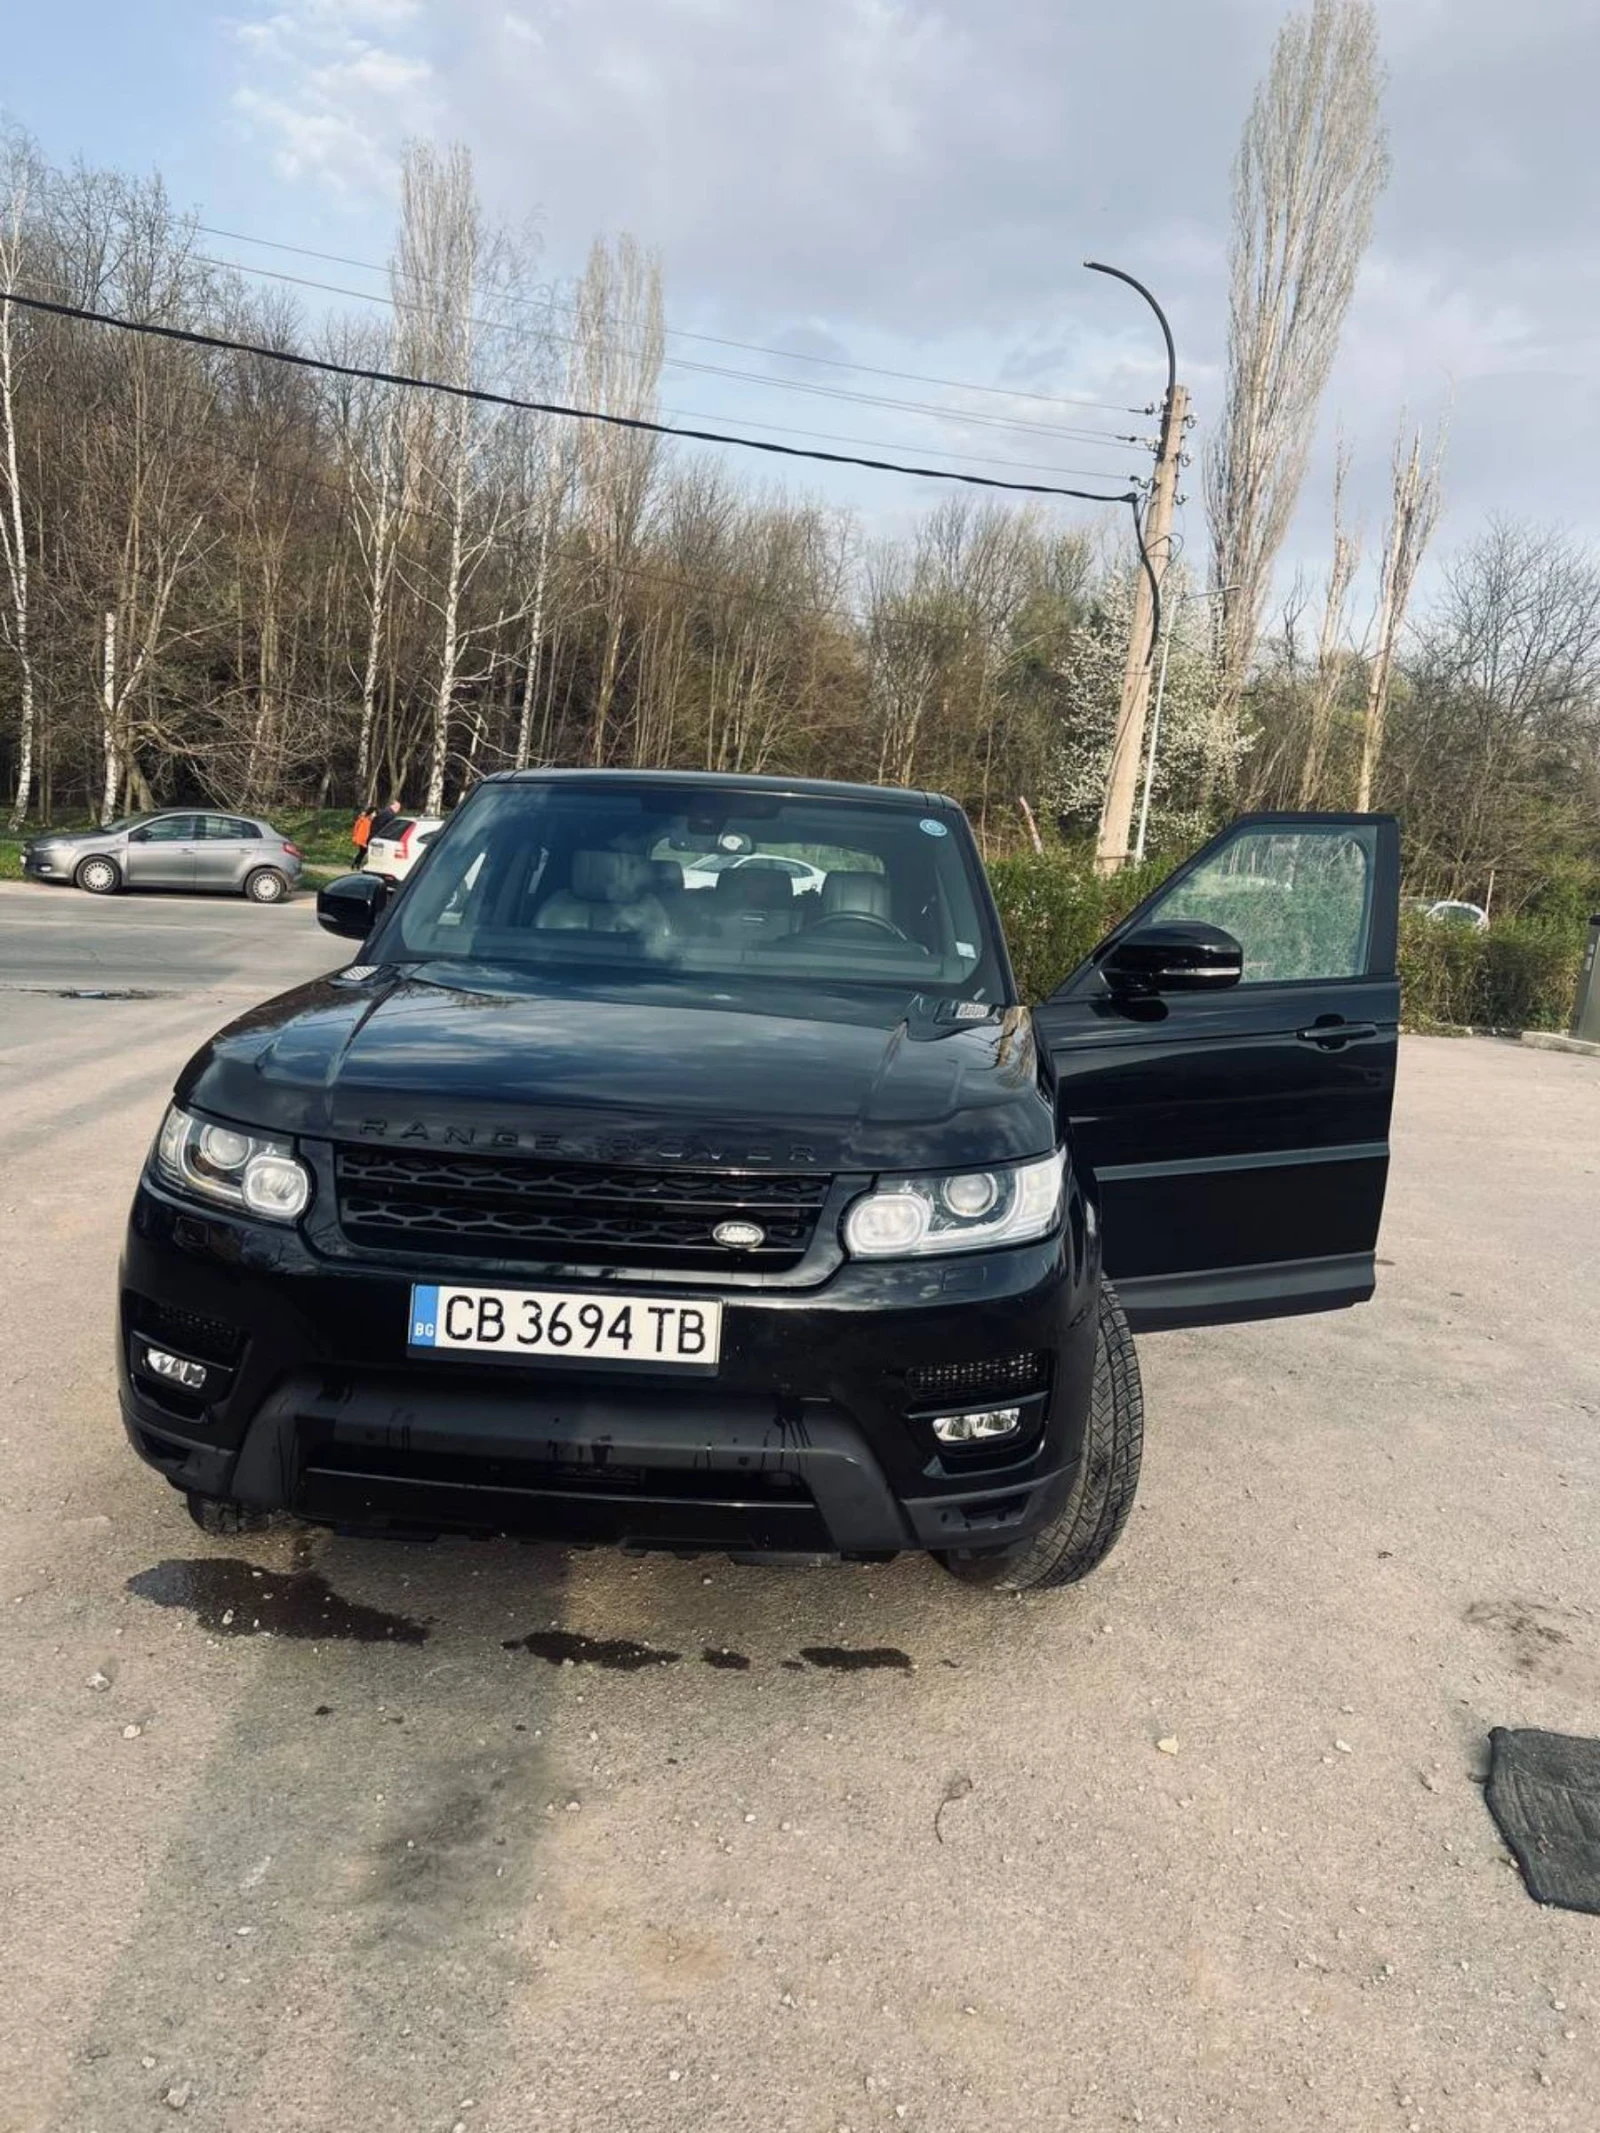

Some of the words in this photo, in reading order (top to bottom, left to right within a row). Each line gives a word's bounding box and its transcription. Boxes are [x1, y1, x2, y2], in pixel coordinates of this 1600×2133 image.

[360, 1118, 561, 1149] RANGE
[414, 1323, 435, 1338] BG
[445, 1295, 505, 1343] CB
[516, 1299, 634, 1350] 3694
[647, 1307, 706, 1354] TB
